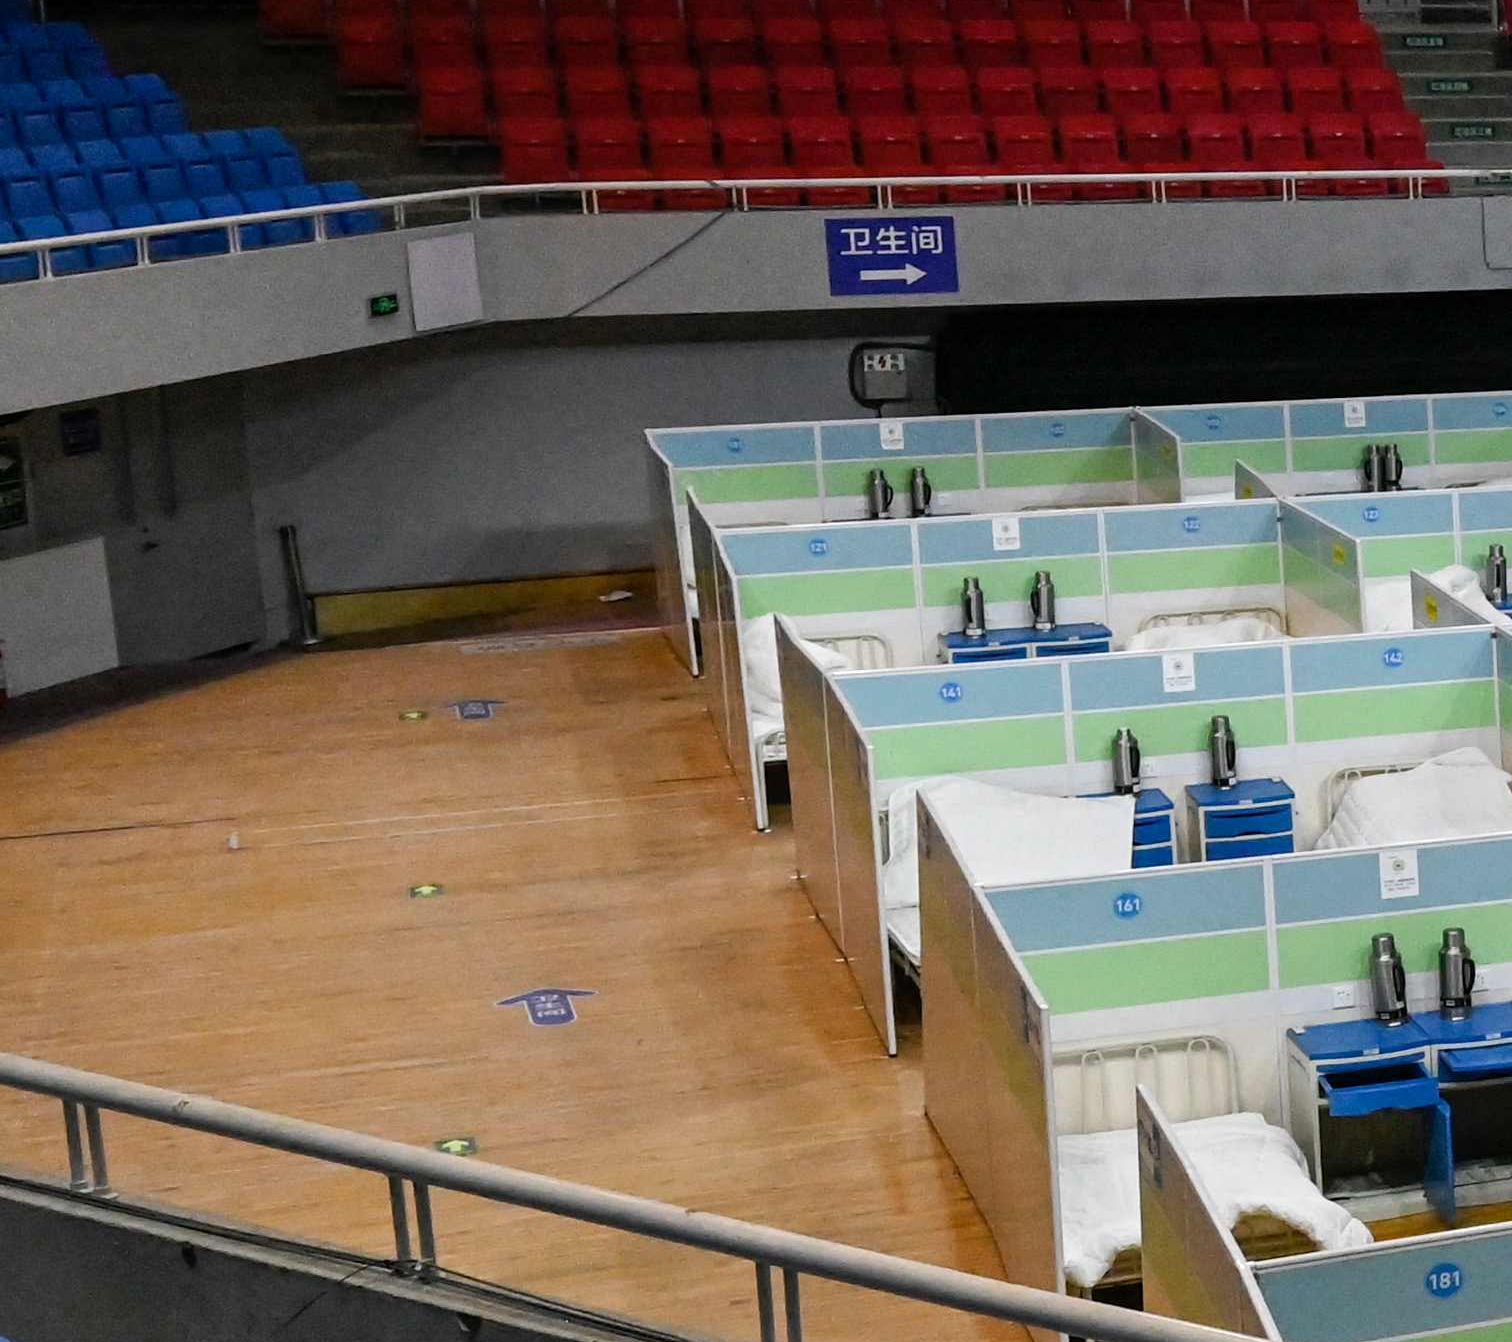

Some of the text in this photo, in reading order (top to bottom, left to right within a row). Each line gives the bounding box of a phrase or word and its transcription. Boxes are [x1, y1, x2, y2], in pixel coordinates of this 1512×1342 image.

[840, 226, 944, 257] 卫生间
[1384, 653, 1402, 663] 142
[942, 687, 961, 698] 141
[1116, 899, 1140, 912] 161
[1429, 1271, 1460, 1289] 181
